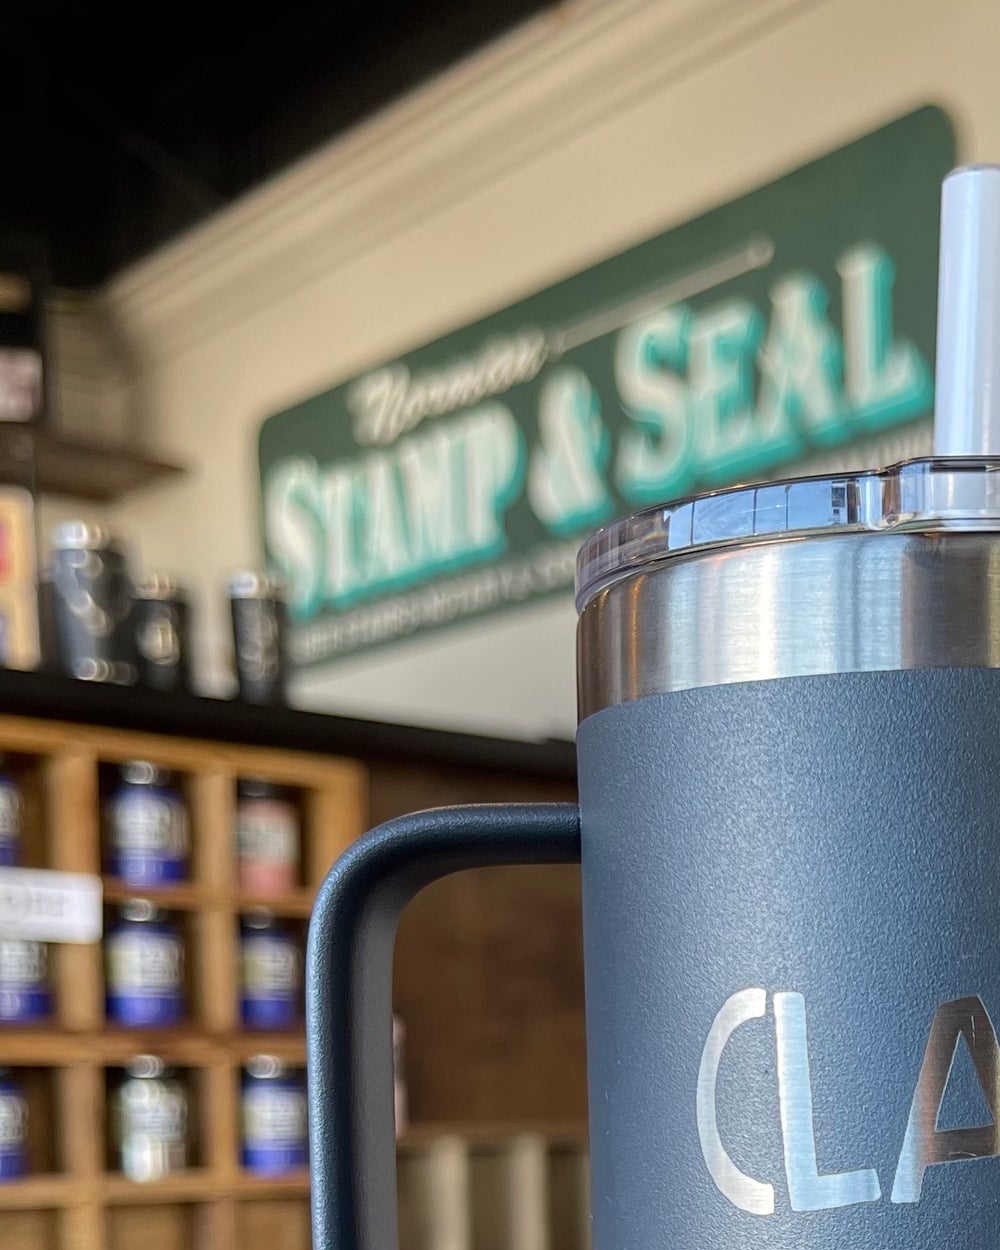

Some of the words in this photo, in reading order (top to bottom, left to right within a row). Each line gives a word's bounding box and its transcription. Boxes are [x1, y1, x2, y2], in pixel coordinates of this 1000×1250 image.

[264, 402, 525, 624] STAMP
[528, 365, 614, 537] &
[613, 240, 935, 502] SEAL
